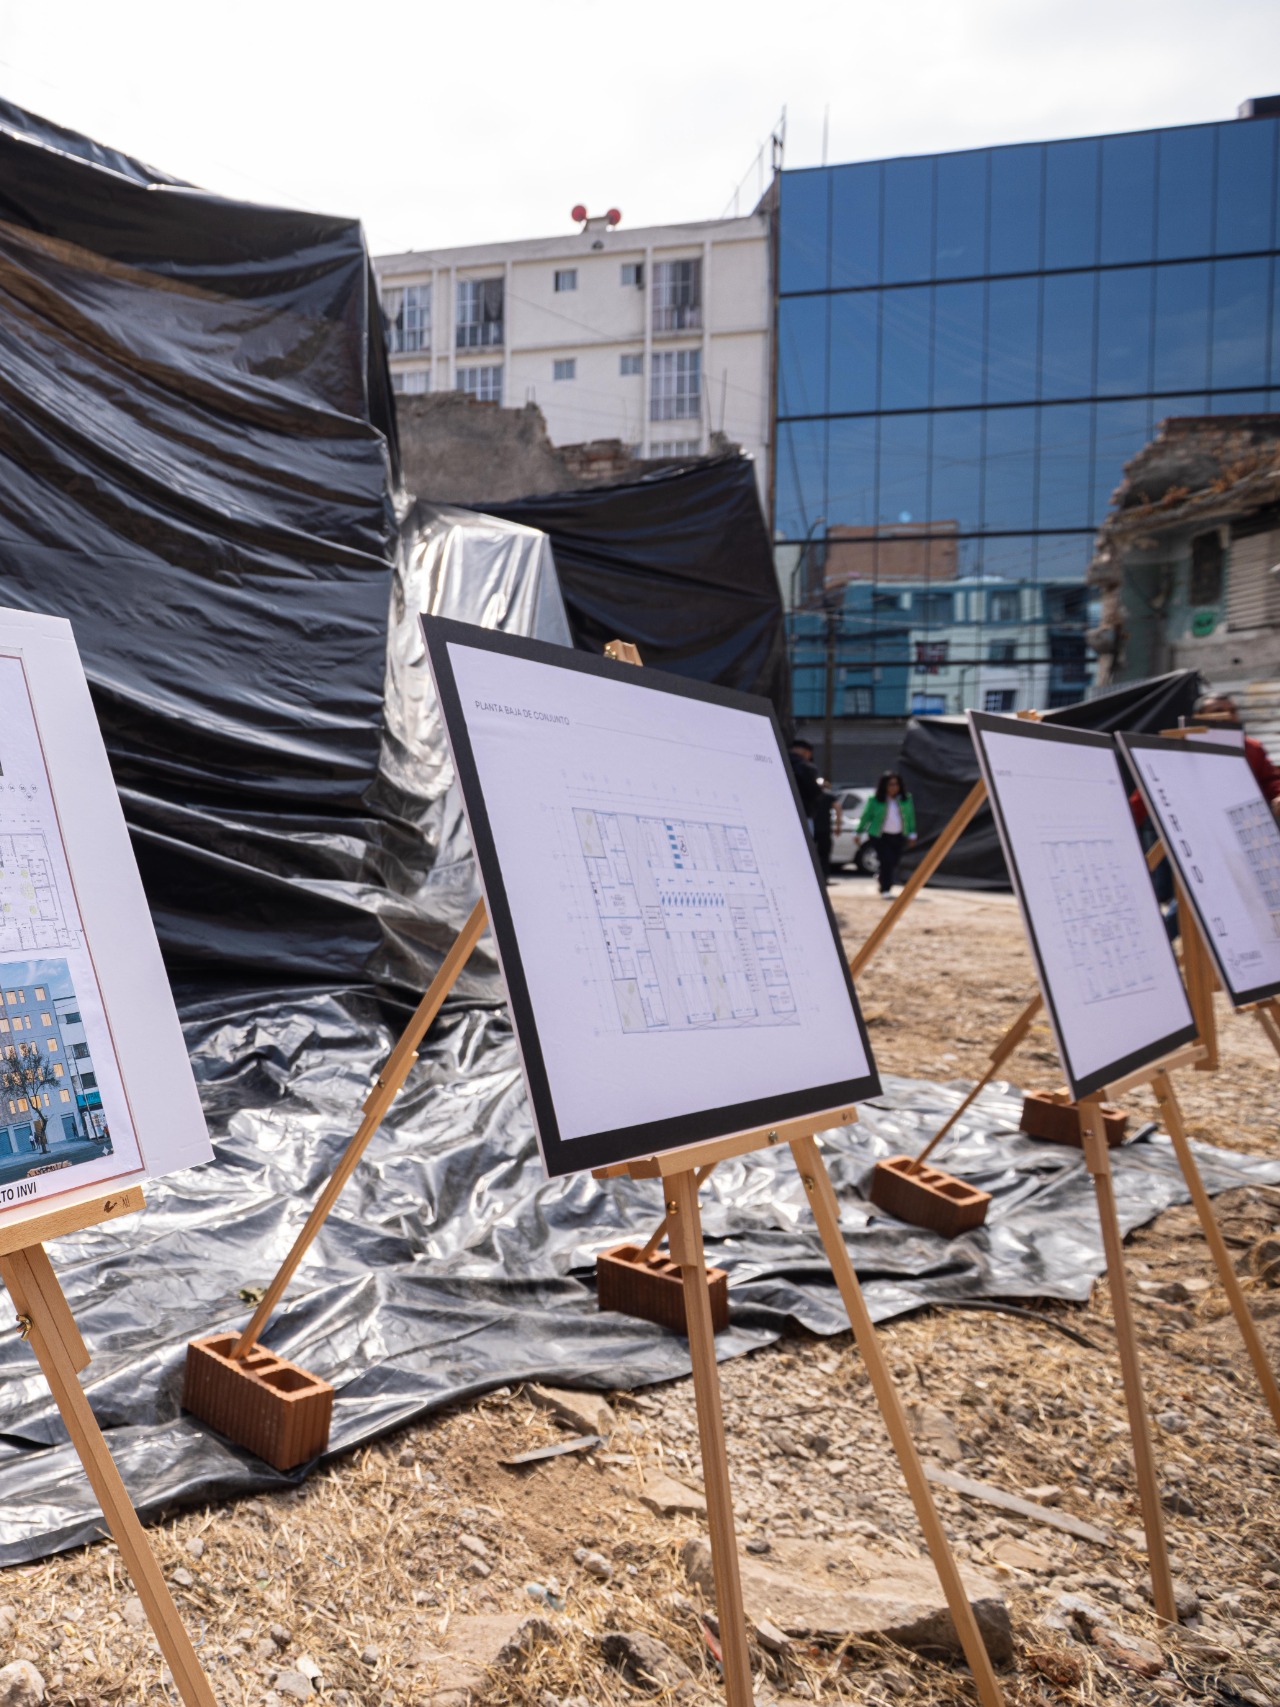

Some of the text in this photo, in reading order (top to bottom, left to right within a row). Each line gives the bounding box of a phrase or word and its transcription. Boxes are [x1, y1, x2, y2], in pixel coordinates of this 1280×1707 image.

[475, 700, 570, 725] PLANTA BAJA DE CONJUNTO
[17, 1181, 38, 1199] INVI
